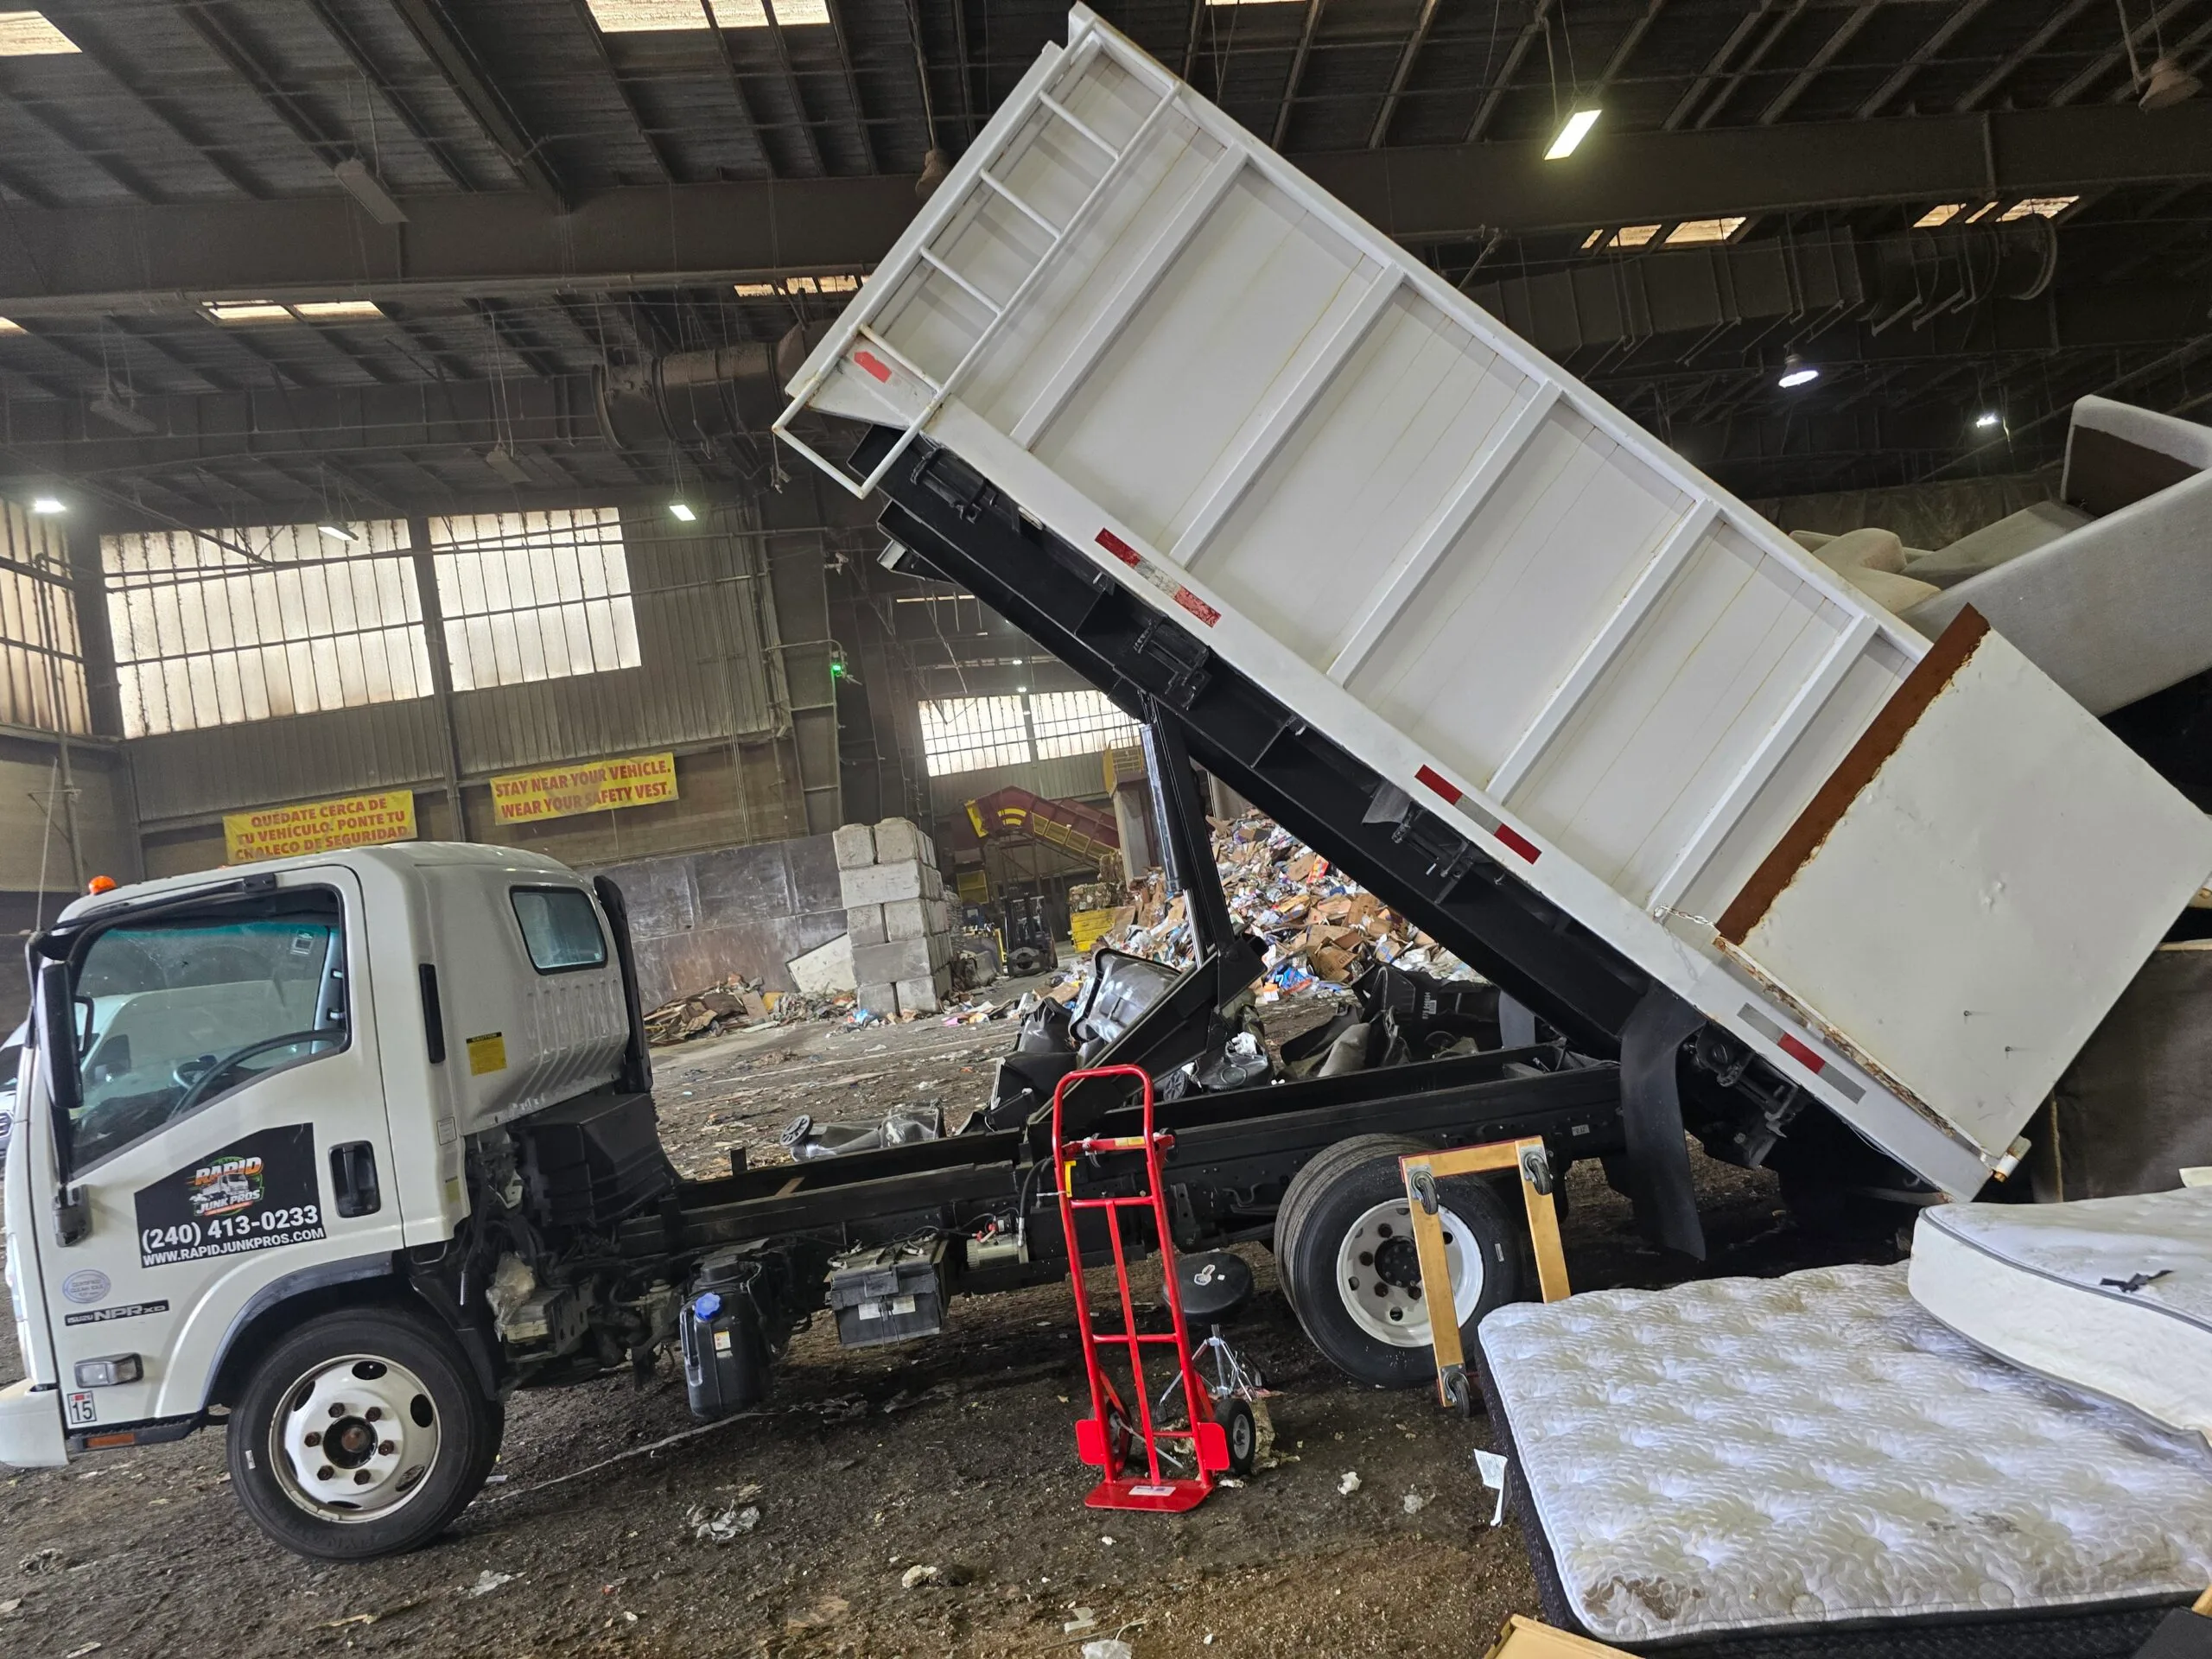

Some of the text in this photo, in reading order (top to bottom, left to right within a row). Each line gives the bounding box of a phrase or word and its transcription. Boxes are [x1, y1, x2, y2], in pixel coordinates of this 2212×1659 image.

[496, 760, 671, 798] STAY NEAR YOUR VEHICLE.
[320, 801, 366, 817] CERCA
[369, 798, 387, 811] DE
[501, 782, 672, 818] WEAR YOUR SAFETY VEST.
[238, 834, 255, 845] TU
[337, 815, 385, 830] PONTE
[387, 810, 405, 823] TU
[304, 839, 321, 851] DE
[195, 1157, 262, 1185] RAPID
[196, 1198, 229, 1214] JUNK
[230, 1189, 261, 1205] PROS
[142, 1222, 201, 1254] (240)
[207, 1205, 318, 1239] 413-0233
[143, 1227, 324, 1267] WWW.RAPIDJUNKPROS.COM
[67, 1314, 93, 1324] ISUZU
[94, 1305, 143, 1321] NPR
[72, 1400, 92, 1421] 15
